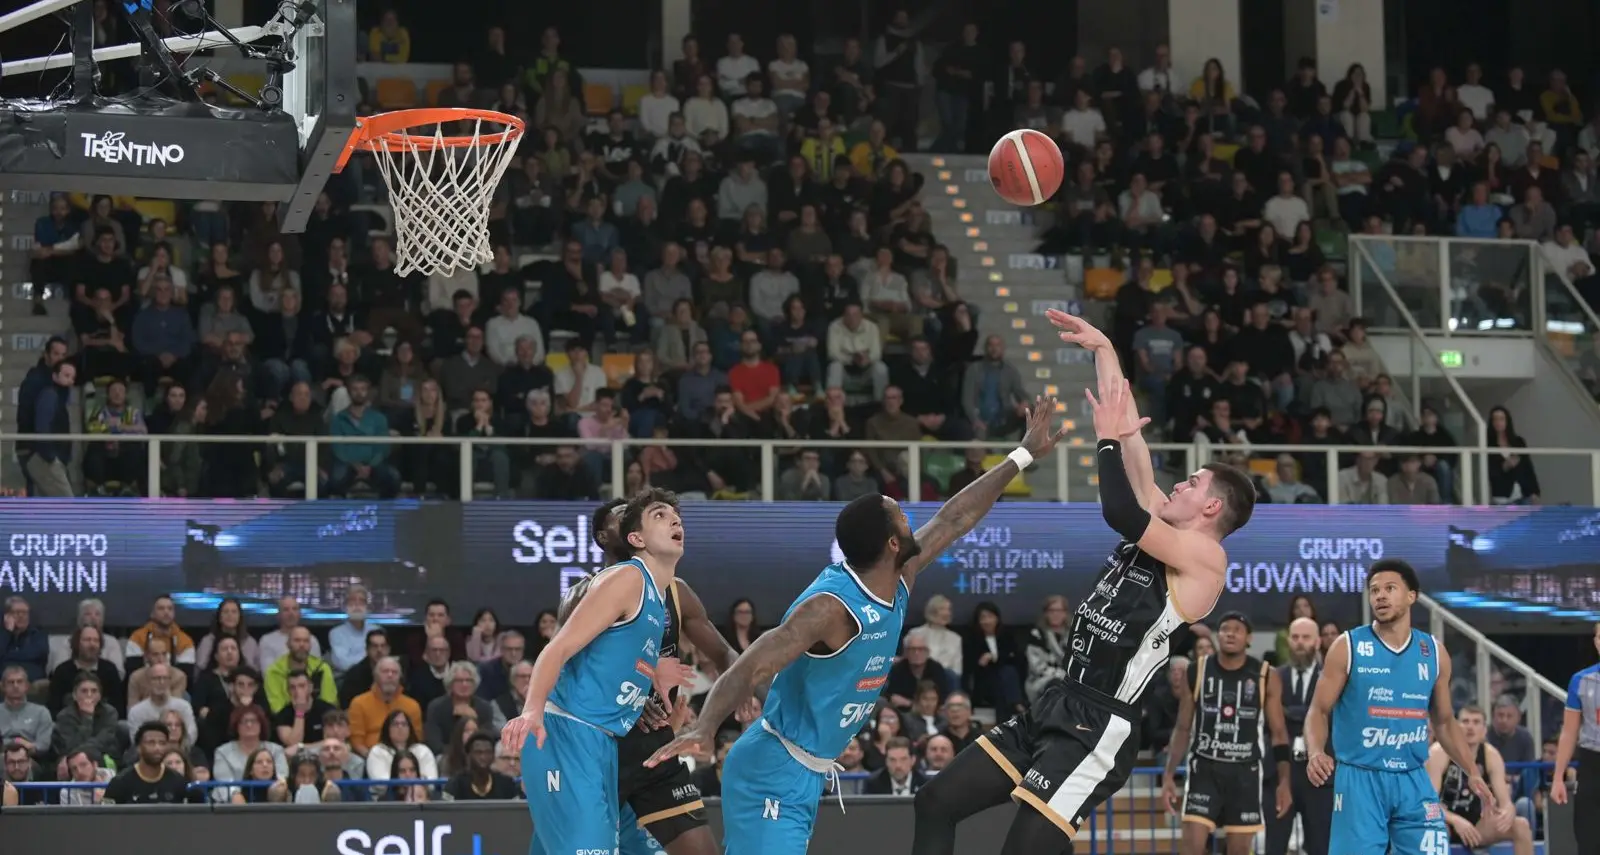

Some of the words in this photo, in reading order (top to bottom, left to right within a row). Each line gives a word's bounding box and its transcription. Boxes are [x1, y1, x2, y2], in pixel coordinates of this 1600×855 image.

[80, 132, 184, 167] TRENTINO
[10, 534, 107, 556] GRUPPO
[1299, 537, 1384, 560] GRUPPO
[0, 561, 107, 592] ANNINI
[1226, 562, 1368, 593] GIOVANNIN
[1077, 602, 1126, 635] Dolomiti
[1086, 623, 1119, 644] energia
[1357, 641, 1374, 657] 45
[1418, 663, 1429, 681] N
[1207, 677, 1215, 693] 1
[1361, 725, 1428, 749] Napoli
[1383, 759, 1407, 769] Vera
[547, 770, 560, 792] N
[762, 797, 780, 820] N
[1334, 793, 1343, 812] N
[1420, 830, 1448, 855] 45
